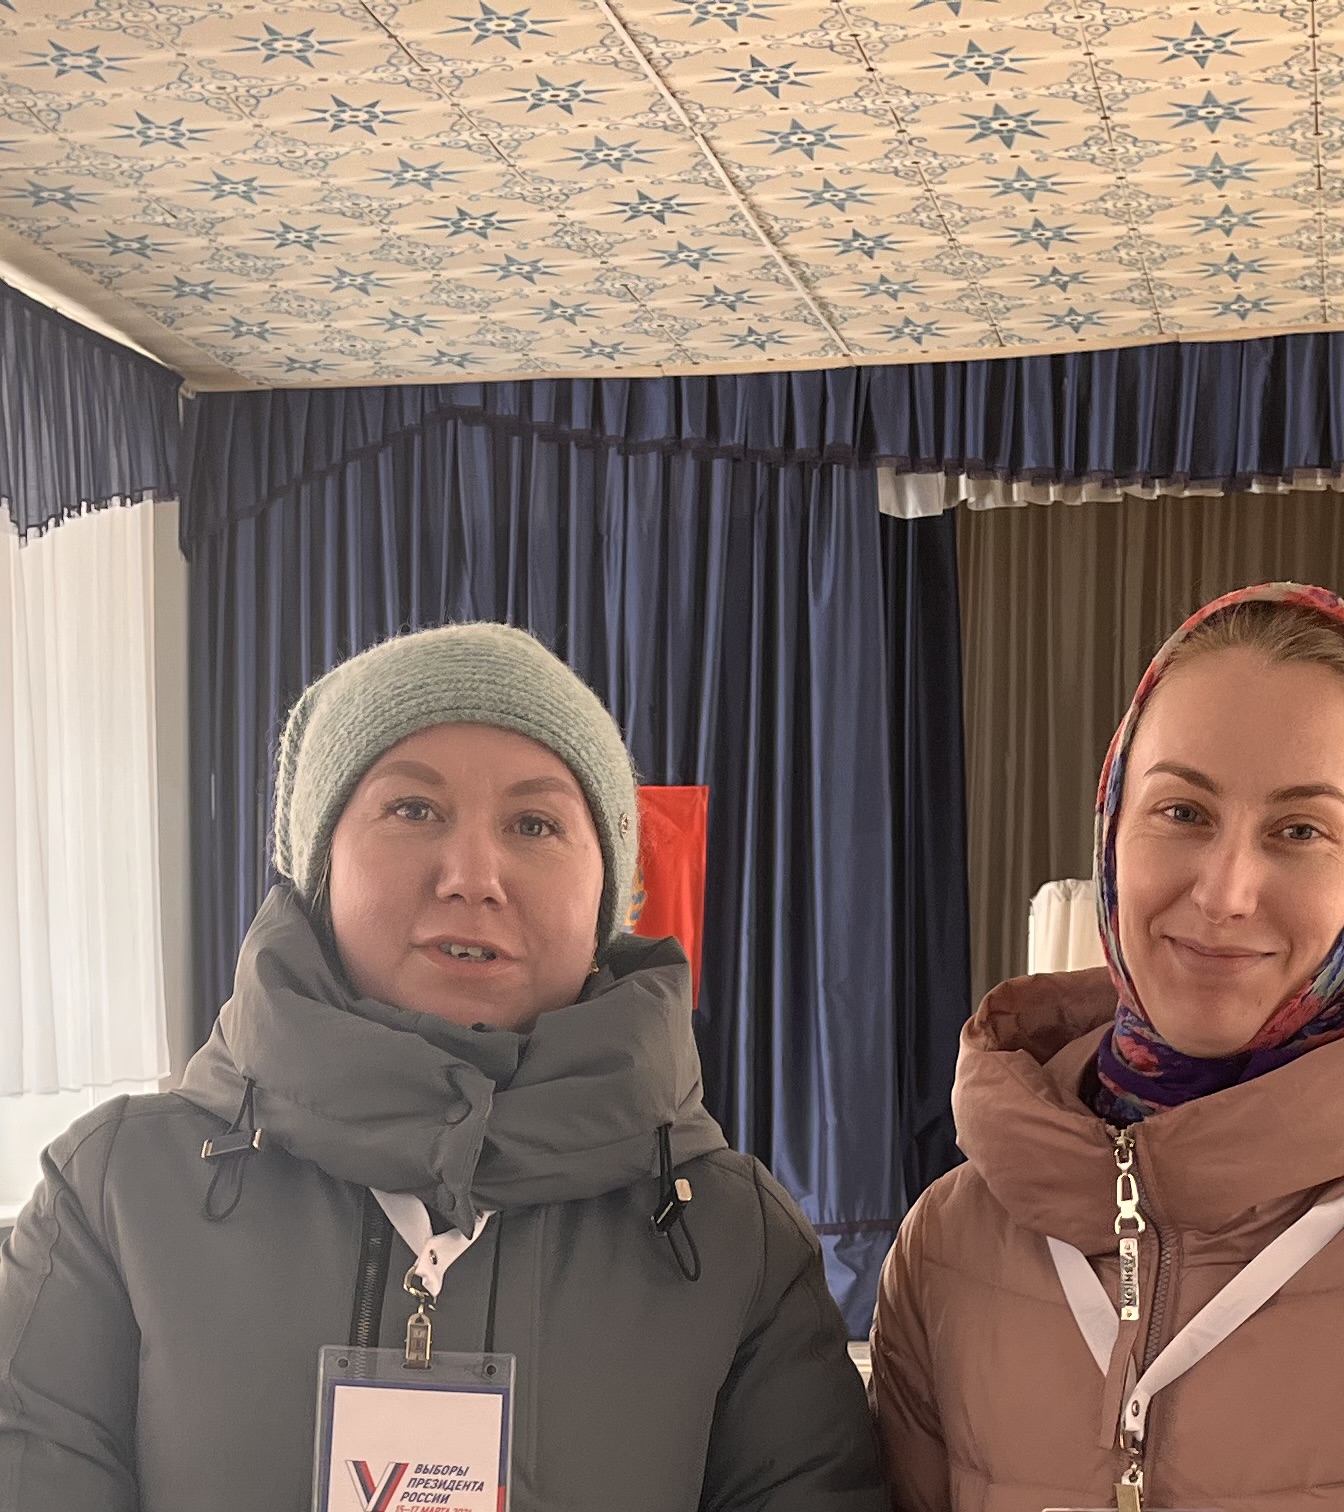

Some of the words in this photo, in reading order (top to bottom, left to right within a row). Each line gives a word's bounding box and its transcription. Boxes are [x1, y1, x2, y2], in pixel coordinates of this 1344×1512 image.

[413, 1463, 470, 1477] ВЫБОРЫ
[406, 1477, 485, 1492] ПРЕЗИДЕНТА
[399, 1491, 452, 1505] РОССИИ
